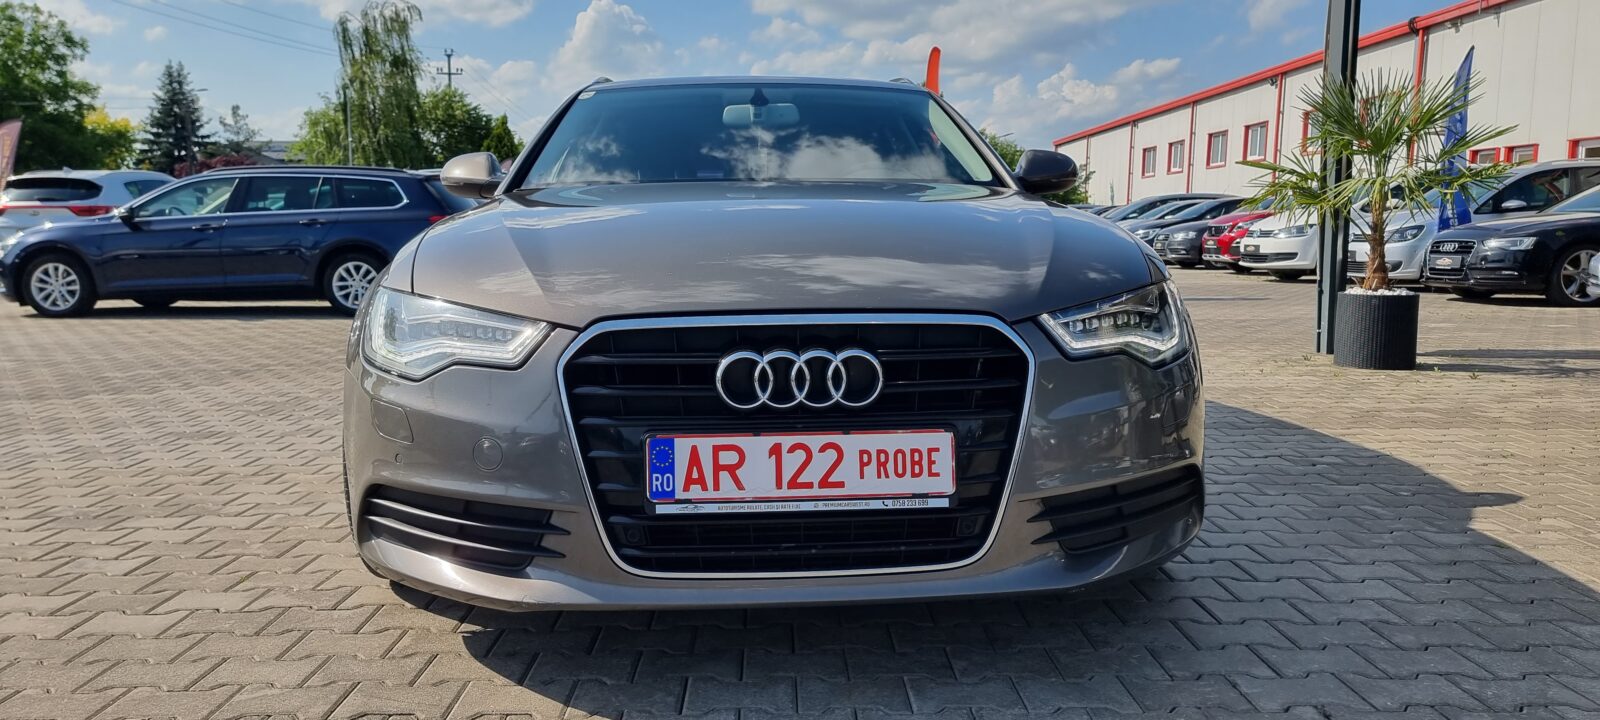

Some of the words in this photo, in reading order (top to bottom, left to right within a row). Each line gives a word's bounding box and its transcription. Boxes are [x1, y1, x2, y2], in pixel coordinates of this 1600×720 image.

[682, 444, 746, 492] AR
[768, 441, 845, 490] 122
[858, 447, 941, 480] PROBE
[652, 473, 673, 492] RO
[891, 499, 906, 507] 0758
[906, 499, 917, 507] 233
